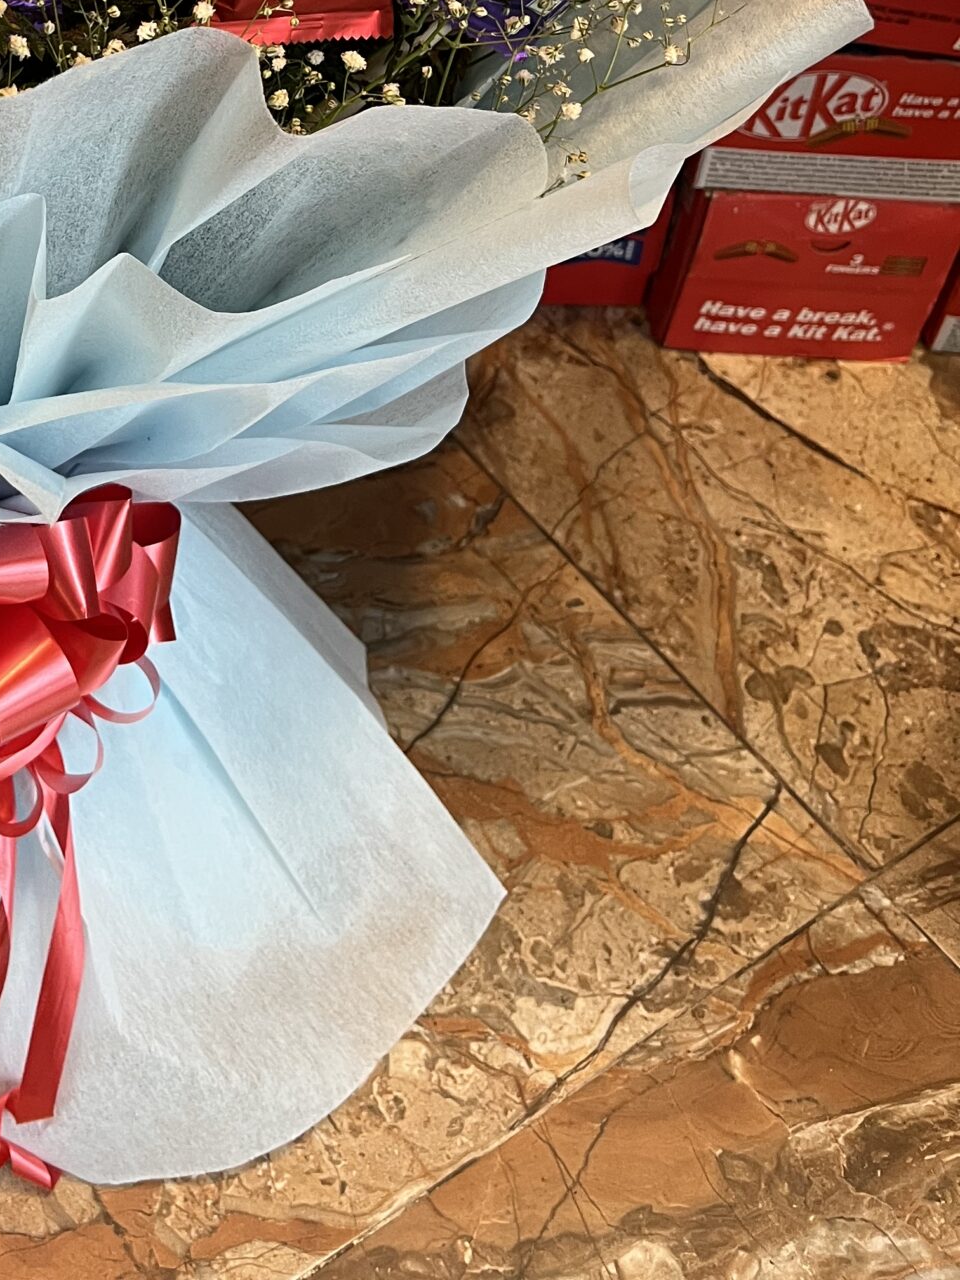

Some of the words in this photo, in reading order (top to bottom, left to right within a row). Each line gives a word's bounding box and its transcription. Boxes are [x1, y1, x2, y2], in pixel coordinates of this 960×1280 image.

[744, 73, 882, 138] KitKat
[899, 92, 943, 107] Have
[892, 106, 935, 119] have
[700, 300, 767, 320] Have
[772, 308, 791, 322] a
[796, 306, 877, 326] break,
[693, 316, 758, 336] have
[763, 324, 783, 338] a
[787, 323, 829, 340] Kit
